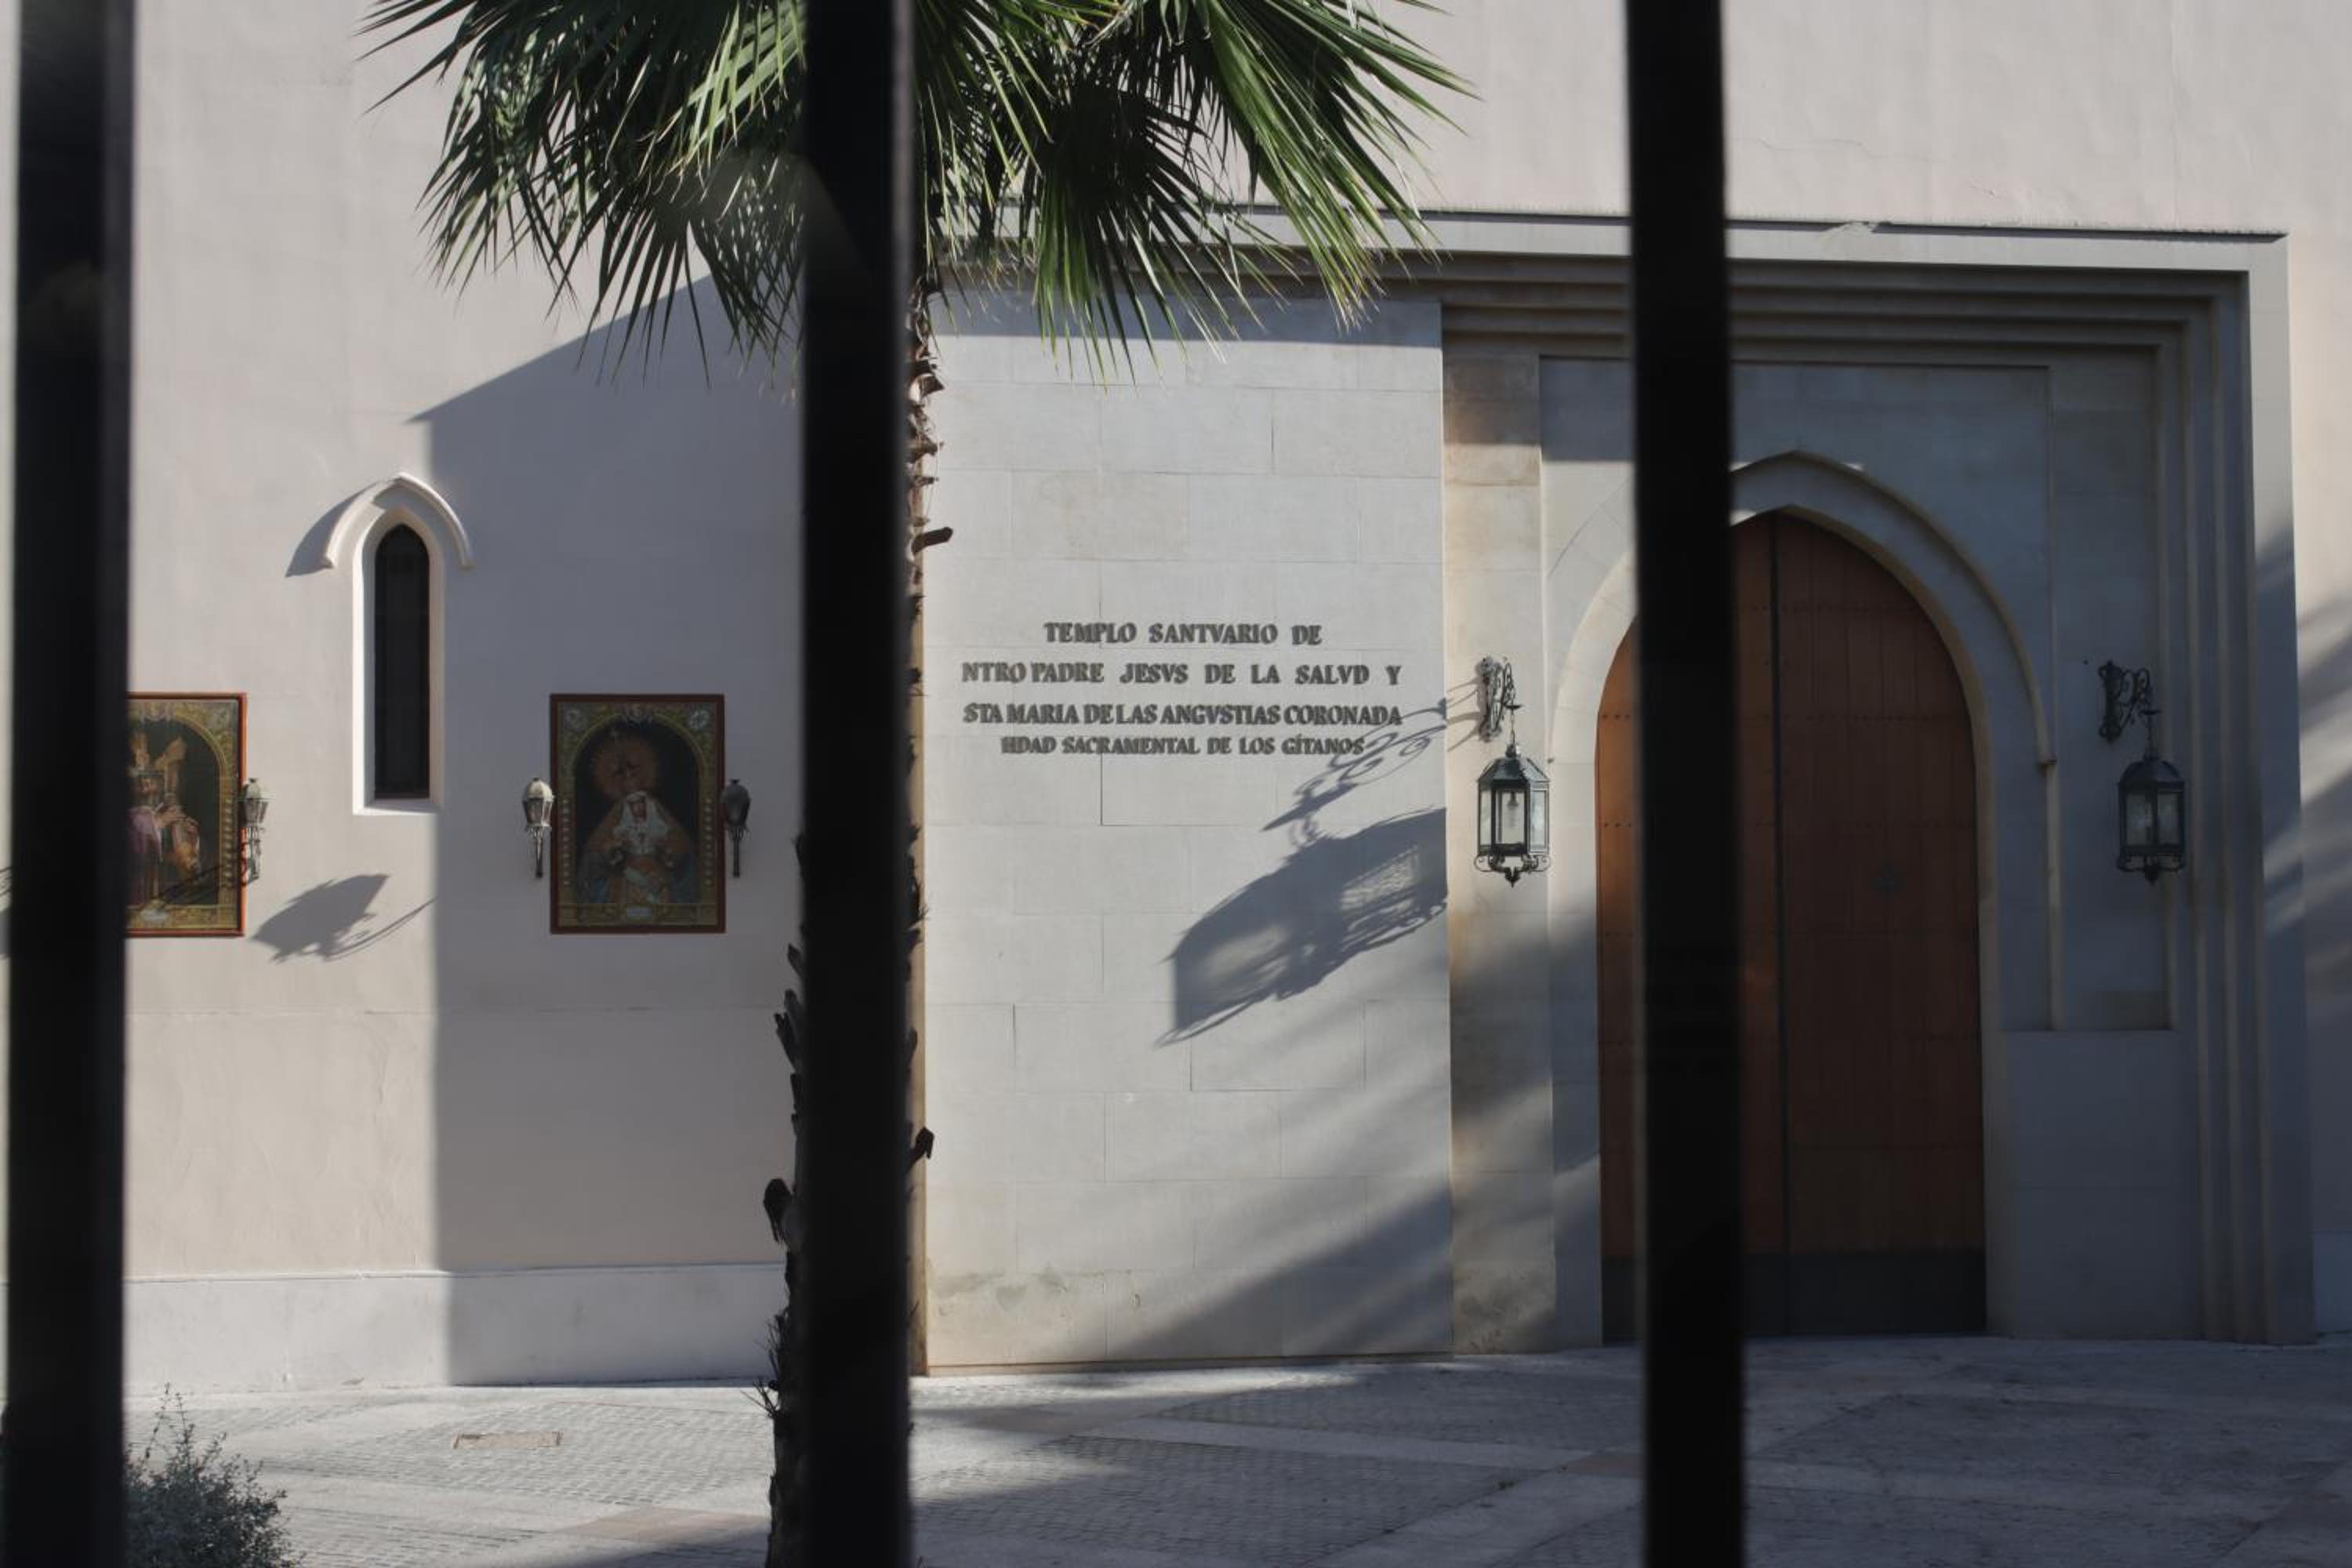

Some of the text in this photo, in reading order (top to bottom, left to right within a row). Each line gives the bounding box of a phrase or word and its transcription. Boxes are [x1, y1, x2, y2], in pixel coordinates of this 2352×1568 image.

[1044, 622, 1323, 645] TEMPLO SANTVARIO DE
[962, 662, 1402, 685] NTRO PADRE JESVS DE LA SALVD Y
[963, 702, 1403, 725] STA MARIA DE LAS ANGVSTIAS CORONADA
[1000, 735, 1056, 753] HDAD
[1062, 735, 1201, 754] SACRAMENTAL
[1207, 737, 1232, 754] DE
[1239, 737, 1276, 754] LOS
